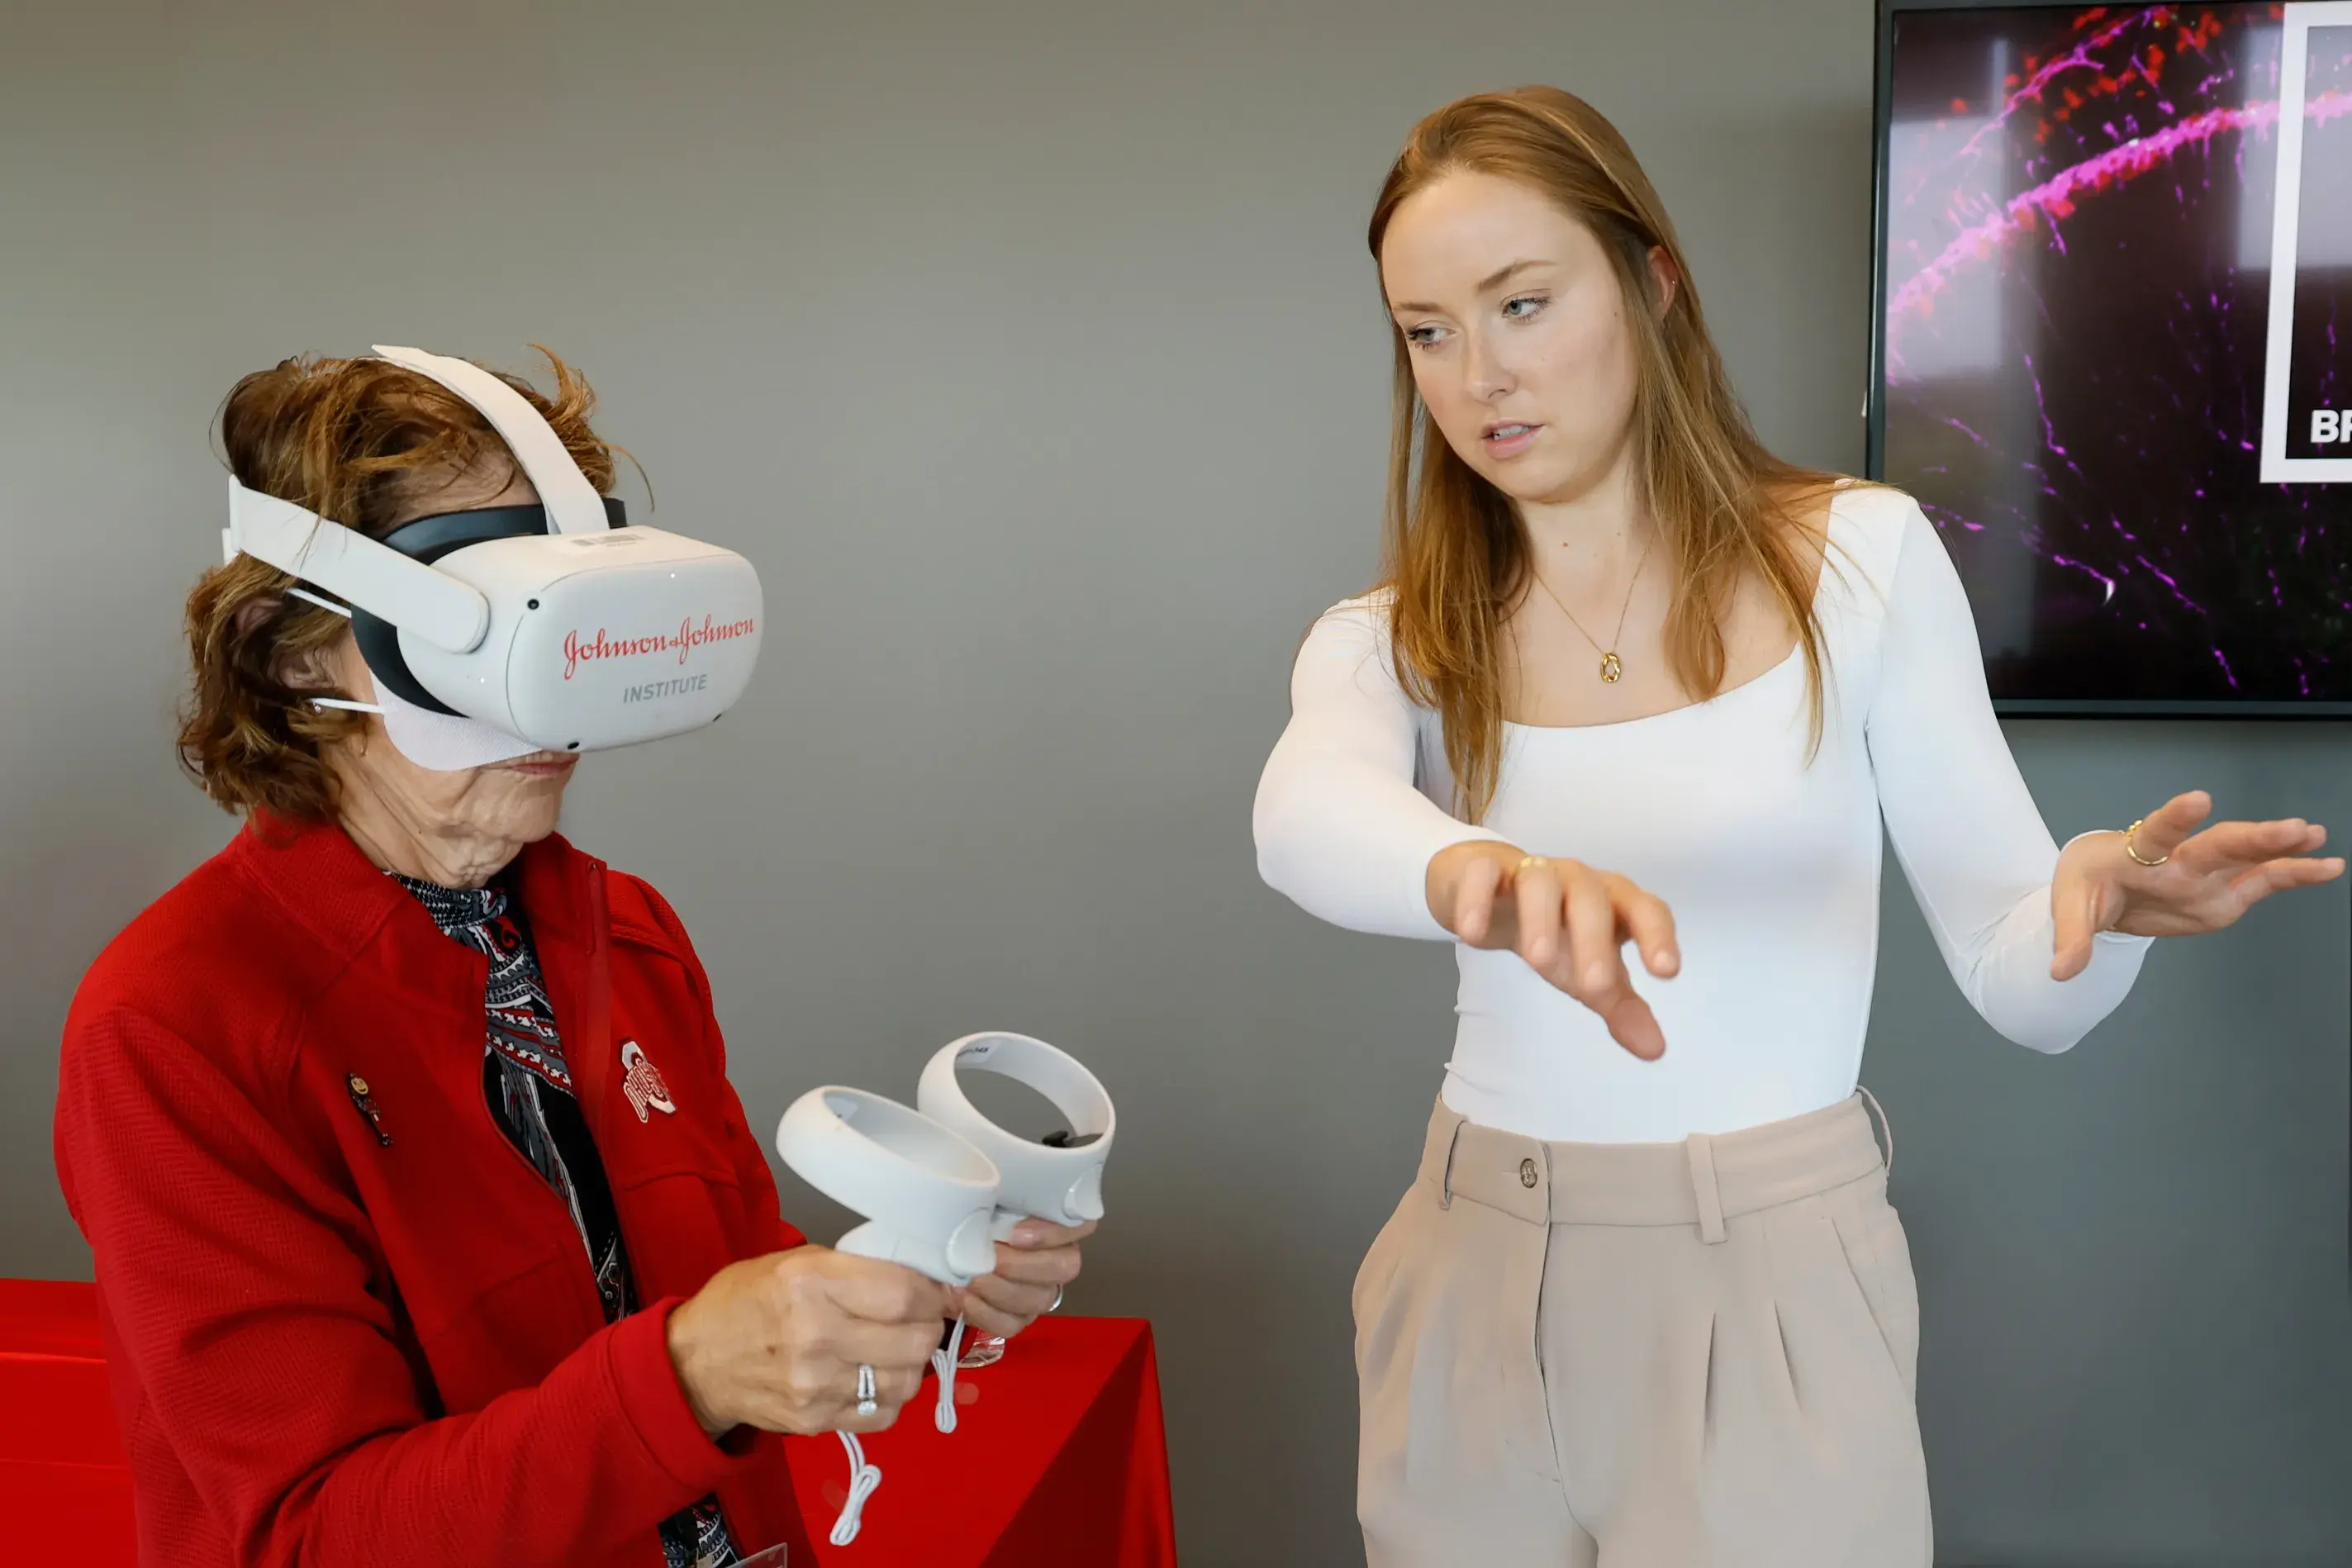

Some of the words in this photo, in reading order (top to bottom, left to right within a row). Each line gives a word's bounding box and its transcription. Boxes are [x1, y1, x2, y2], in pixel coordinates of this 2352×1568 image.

[564, 629, 667, 680] Johnson
[678, 614, 753, 664] Johnson
[624, 674, 707, 704] INSTITUTE
